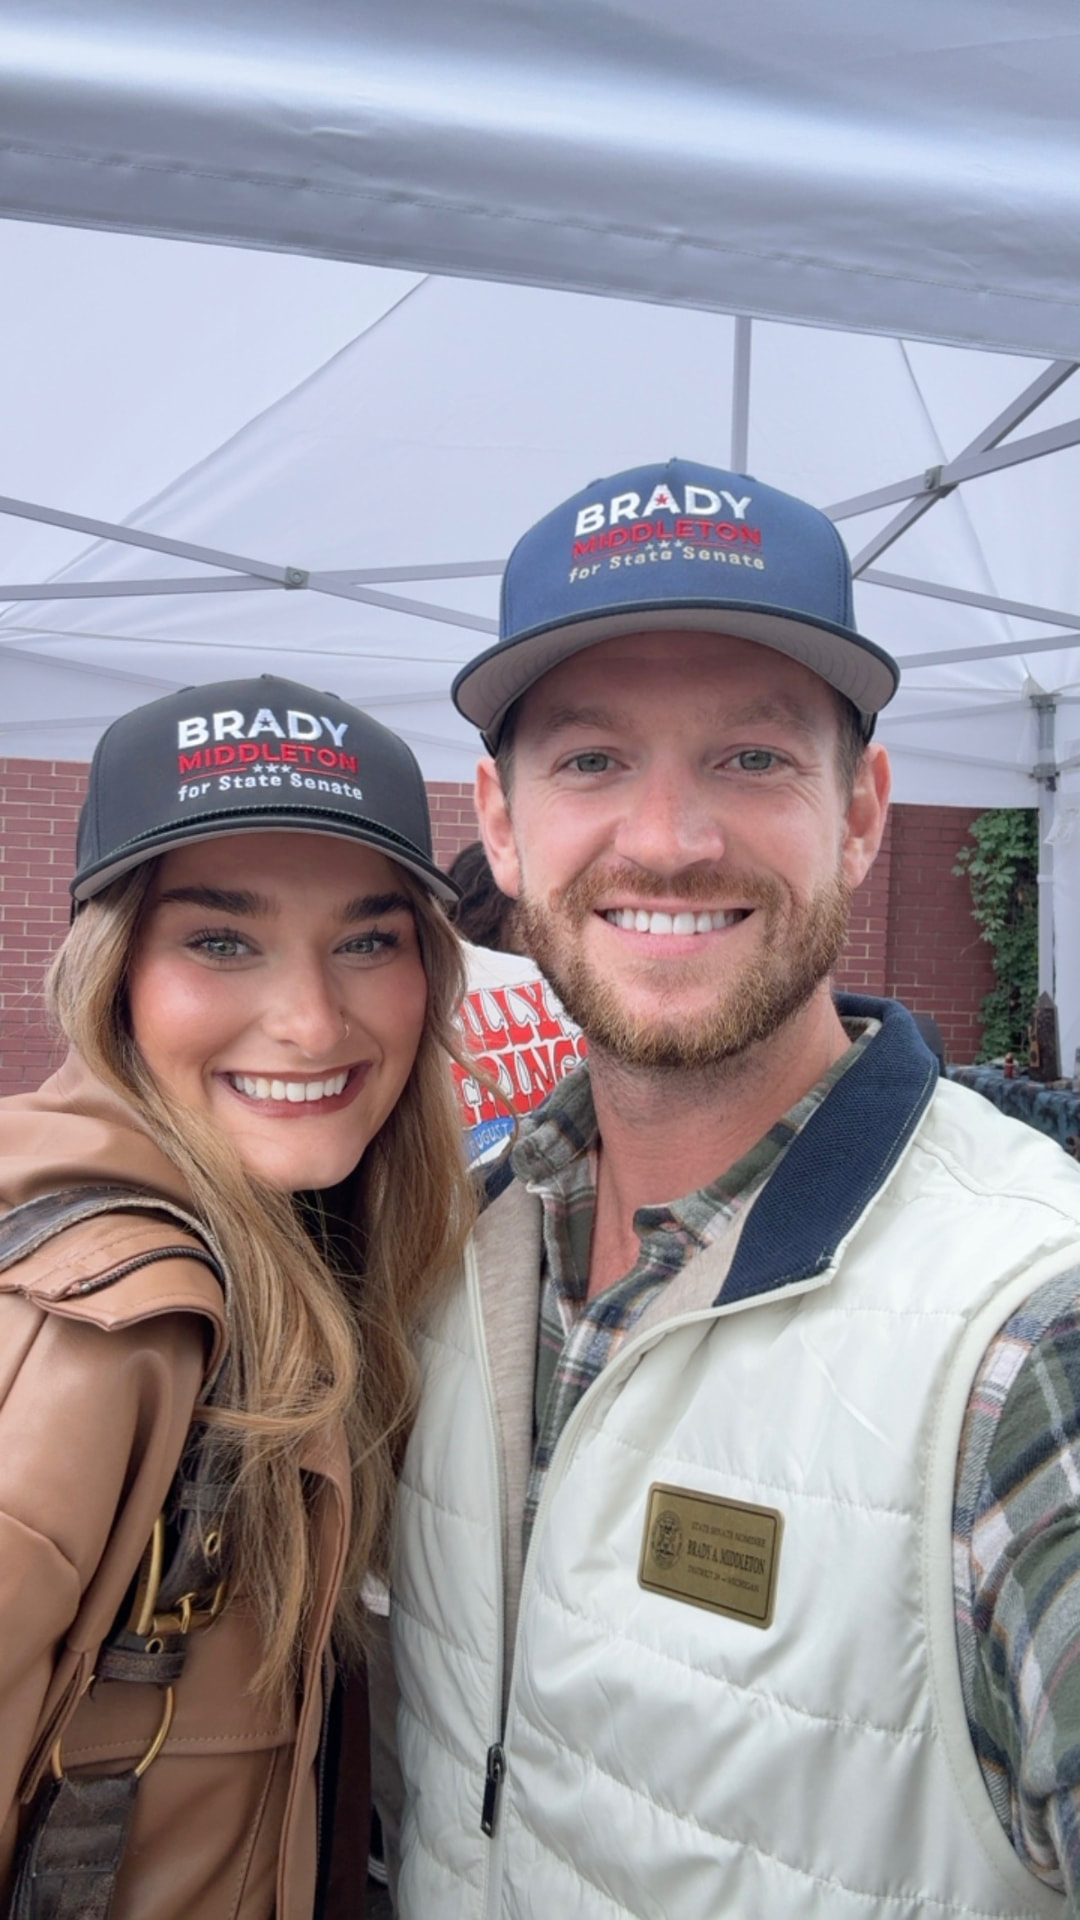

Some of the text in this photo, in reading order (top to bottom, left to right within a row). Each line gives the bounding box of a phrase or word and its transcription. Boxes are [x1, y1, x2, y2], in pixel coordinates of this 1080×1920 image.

[574, 484, 752, 537] BRADY
[572, 518, 762, 559] MIDDLETON
[569, 545, 766, 584] for State Senate
[178, 708, 349, 750] BRADY
[178, 742, 359, 775] MIDDLETON
[177, 771, 364, 802] for State Senate
[458, 979, 563, 1053] ILLY
[687, 1539, 712, 1560] BRADY
[720, 1548, 765, 1575] MIDDLETON
